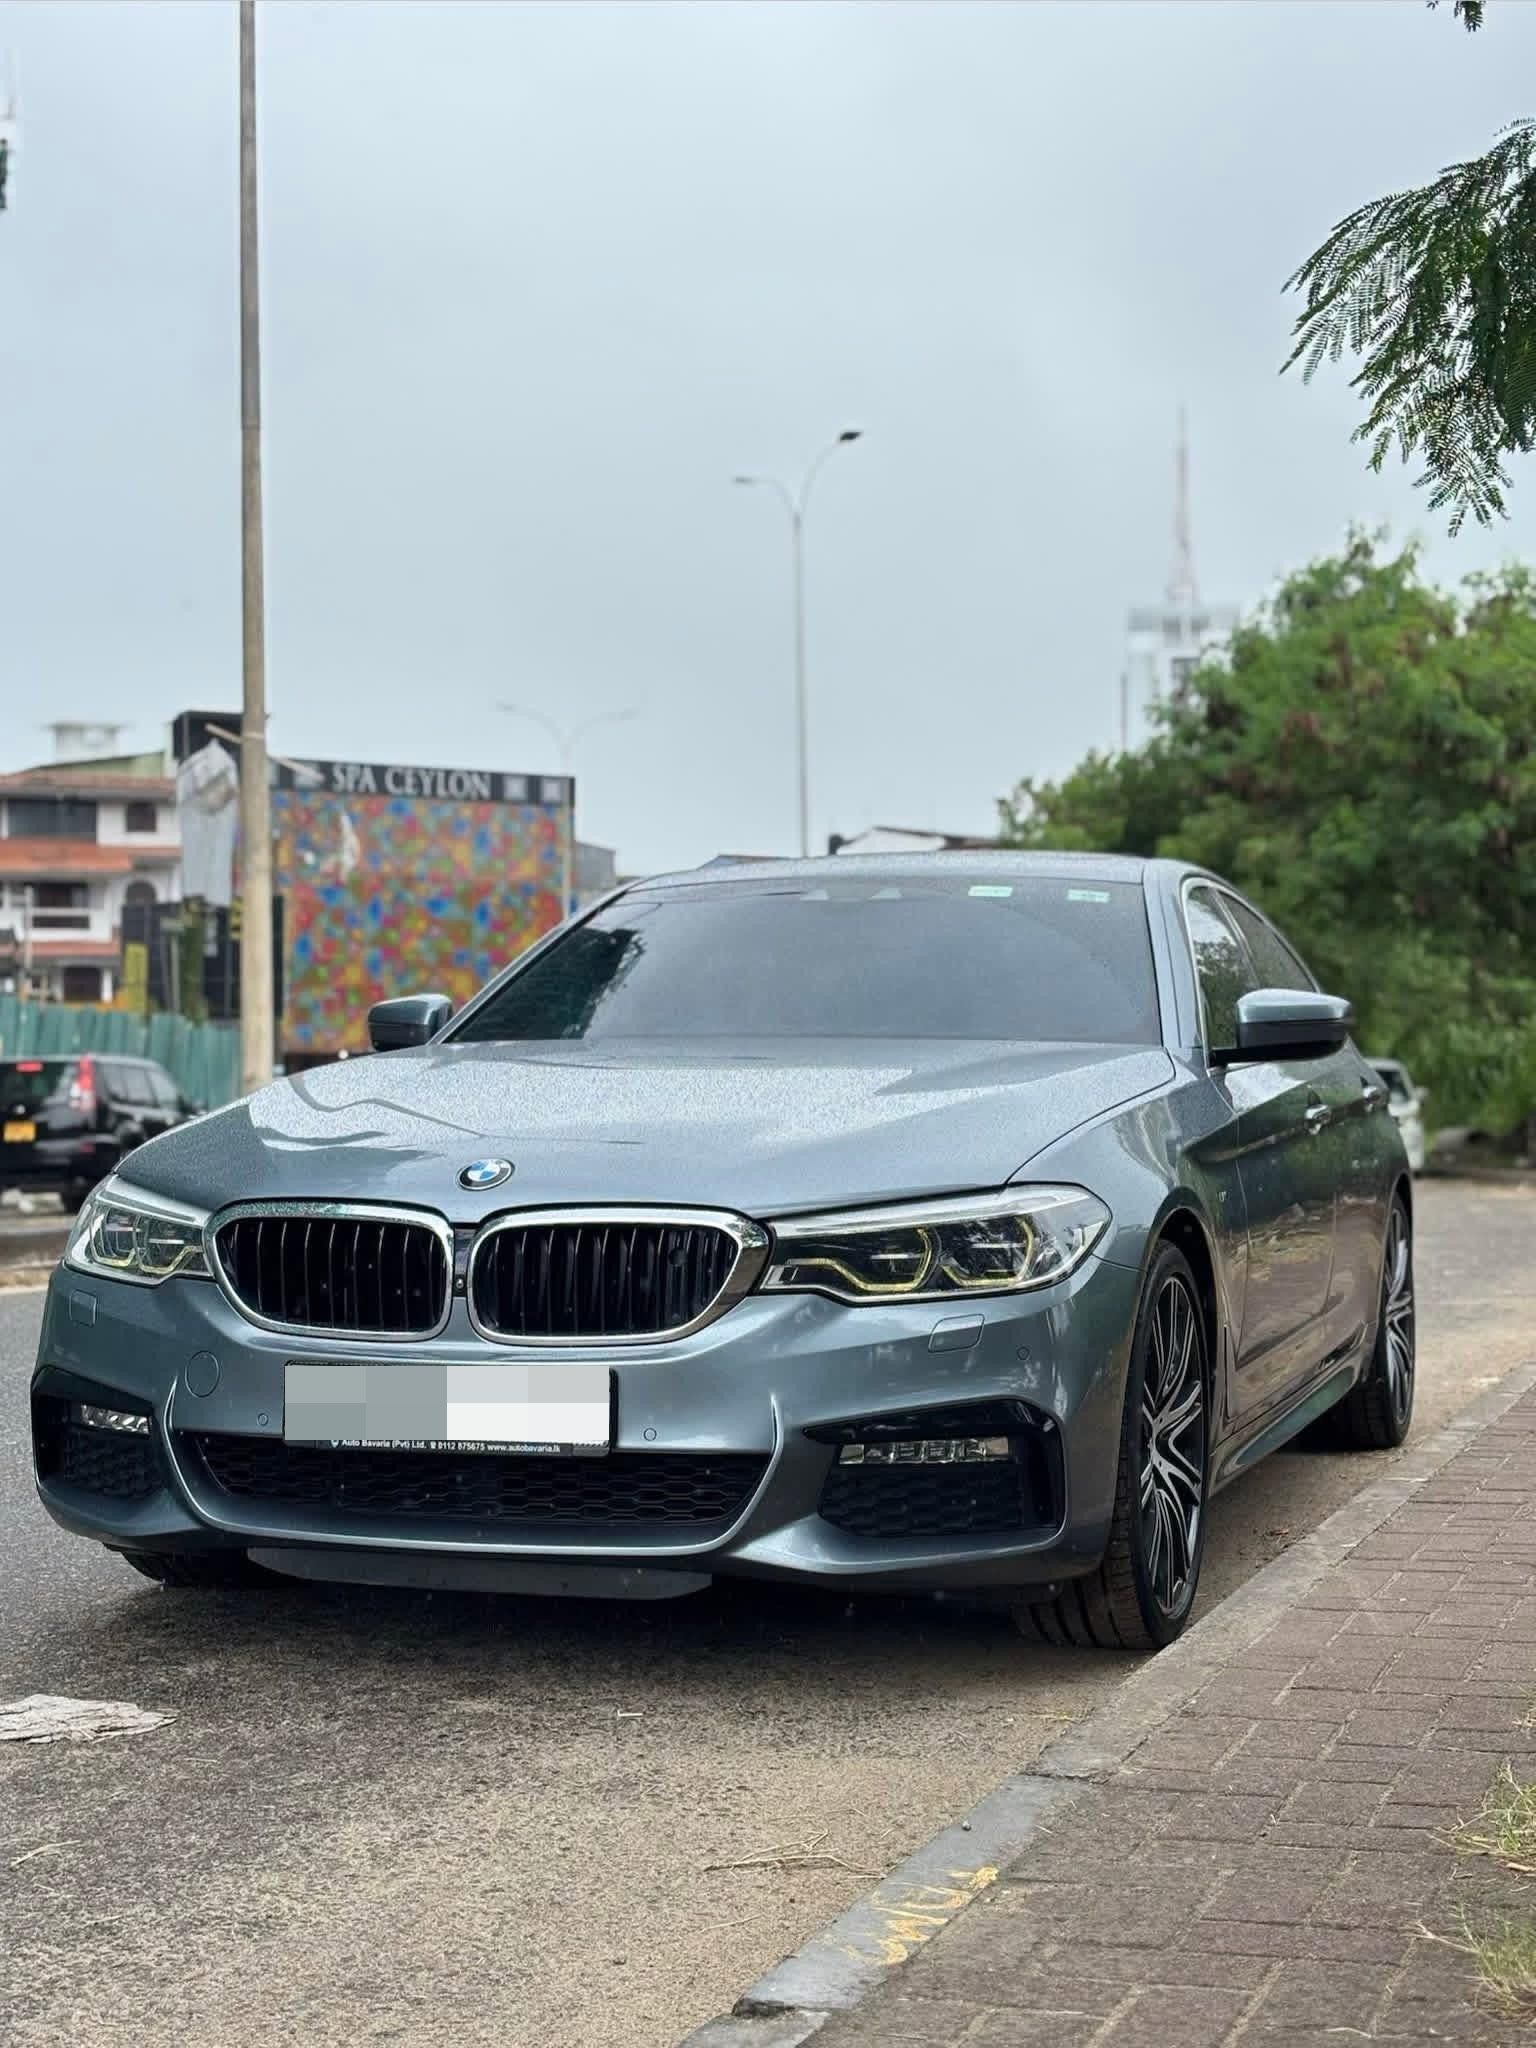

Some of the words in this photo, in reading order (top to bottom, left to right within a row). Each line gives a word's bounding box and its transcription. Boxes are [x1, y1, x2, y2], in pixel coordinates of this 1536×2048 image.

[333, 762, 376, 792] SPA
[385, 765, 491, 800] CEYLON
[362, 1439, 390, 1448] Bavaria
[392, 1440, 410, 1449] (Pvt)
[412, 1441, 427, 1449] Ltd.
[438, 1441, 456, 1450] 0112
